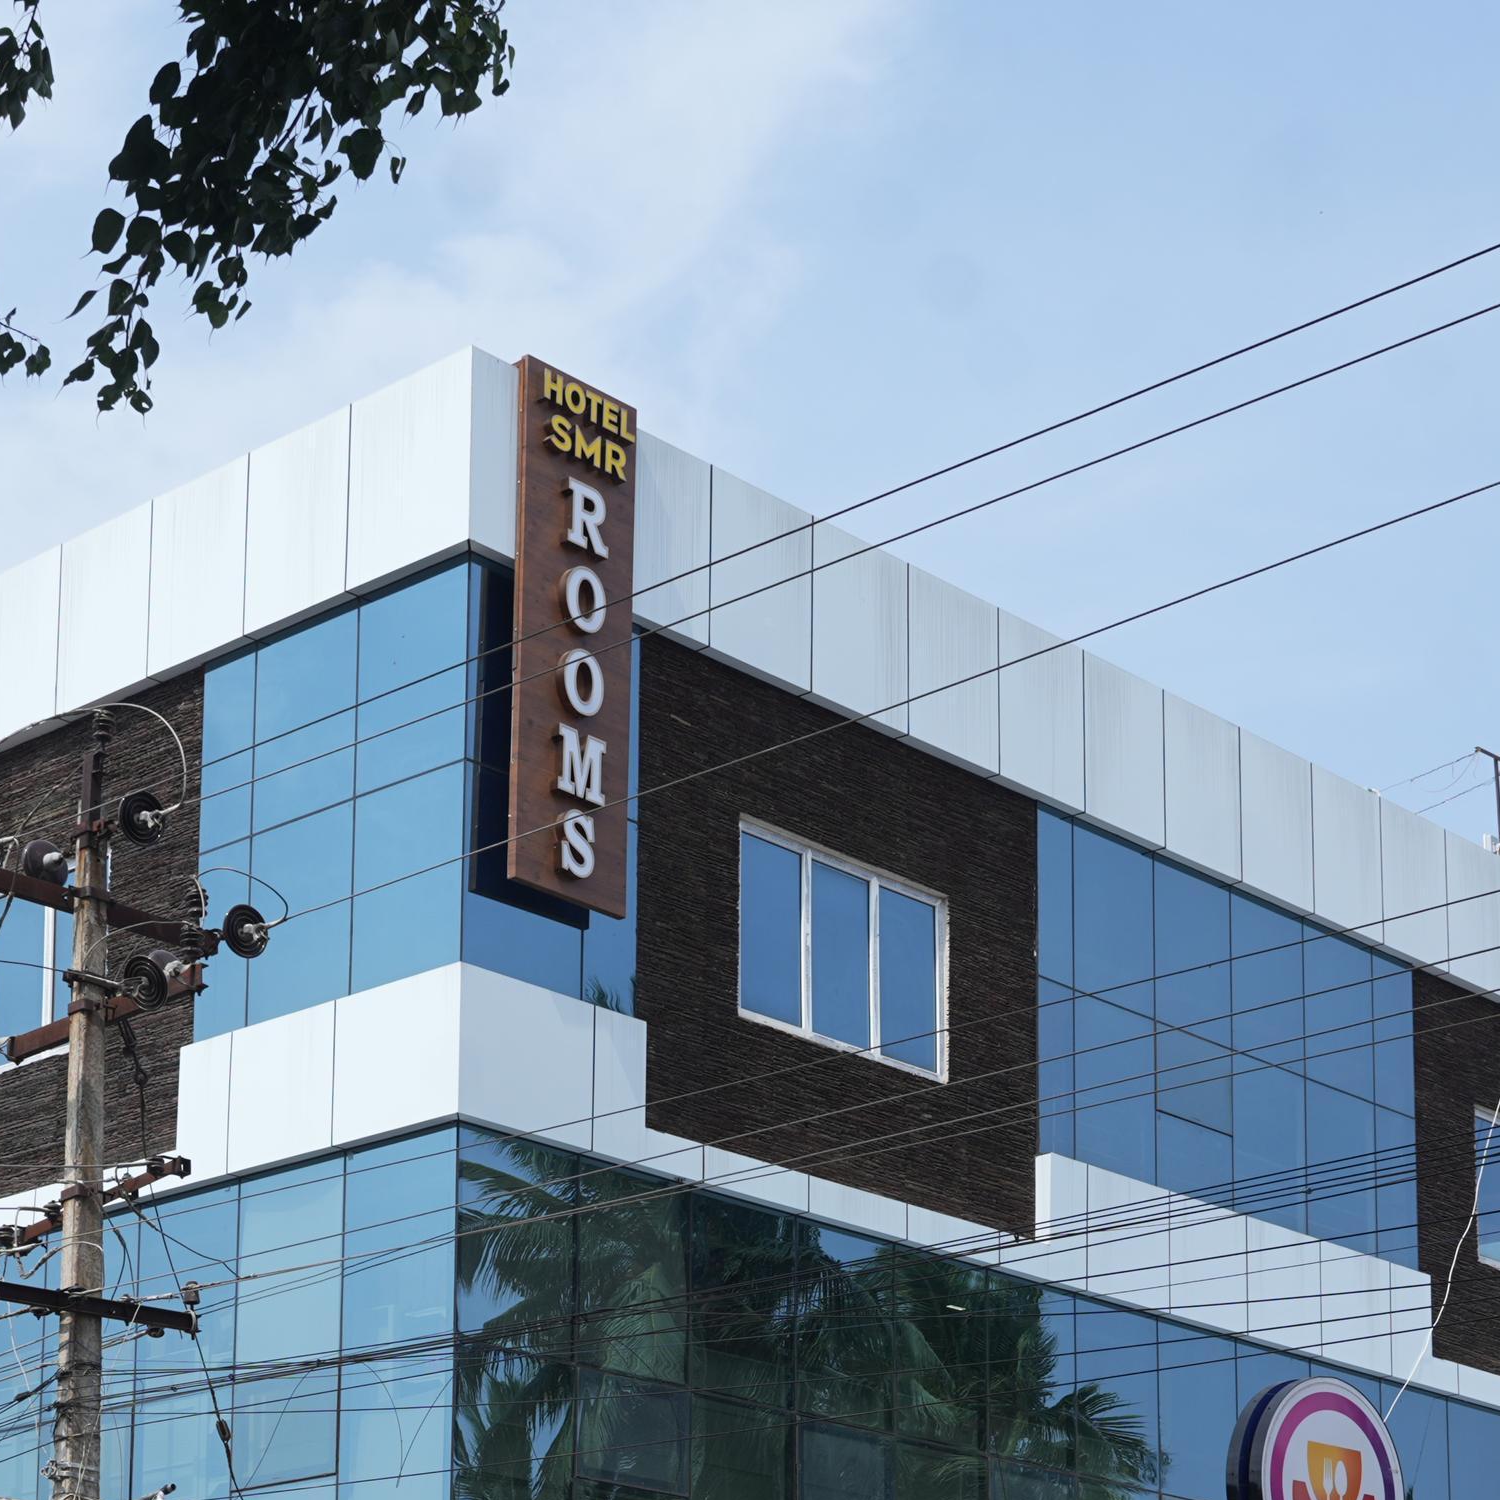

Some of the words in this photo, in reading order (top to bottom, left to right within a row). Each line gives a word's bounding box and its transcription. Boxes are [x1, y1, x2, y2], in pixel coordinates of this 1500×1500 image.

[543, 368, 635, 443] HOTEL
[550, 415, 627, 481] SMR
[557, 476, 609, 880] ROOMS
